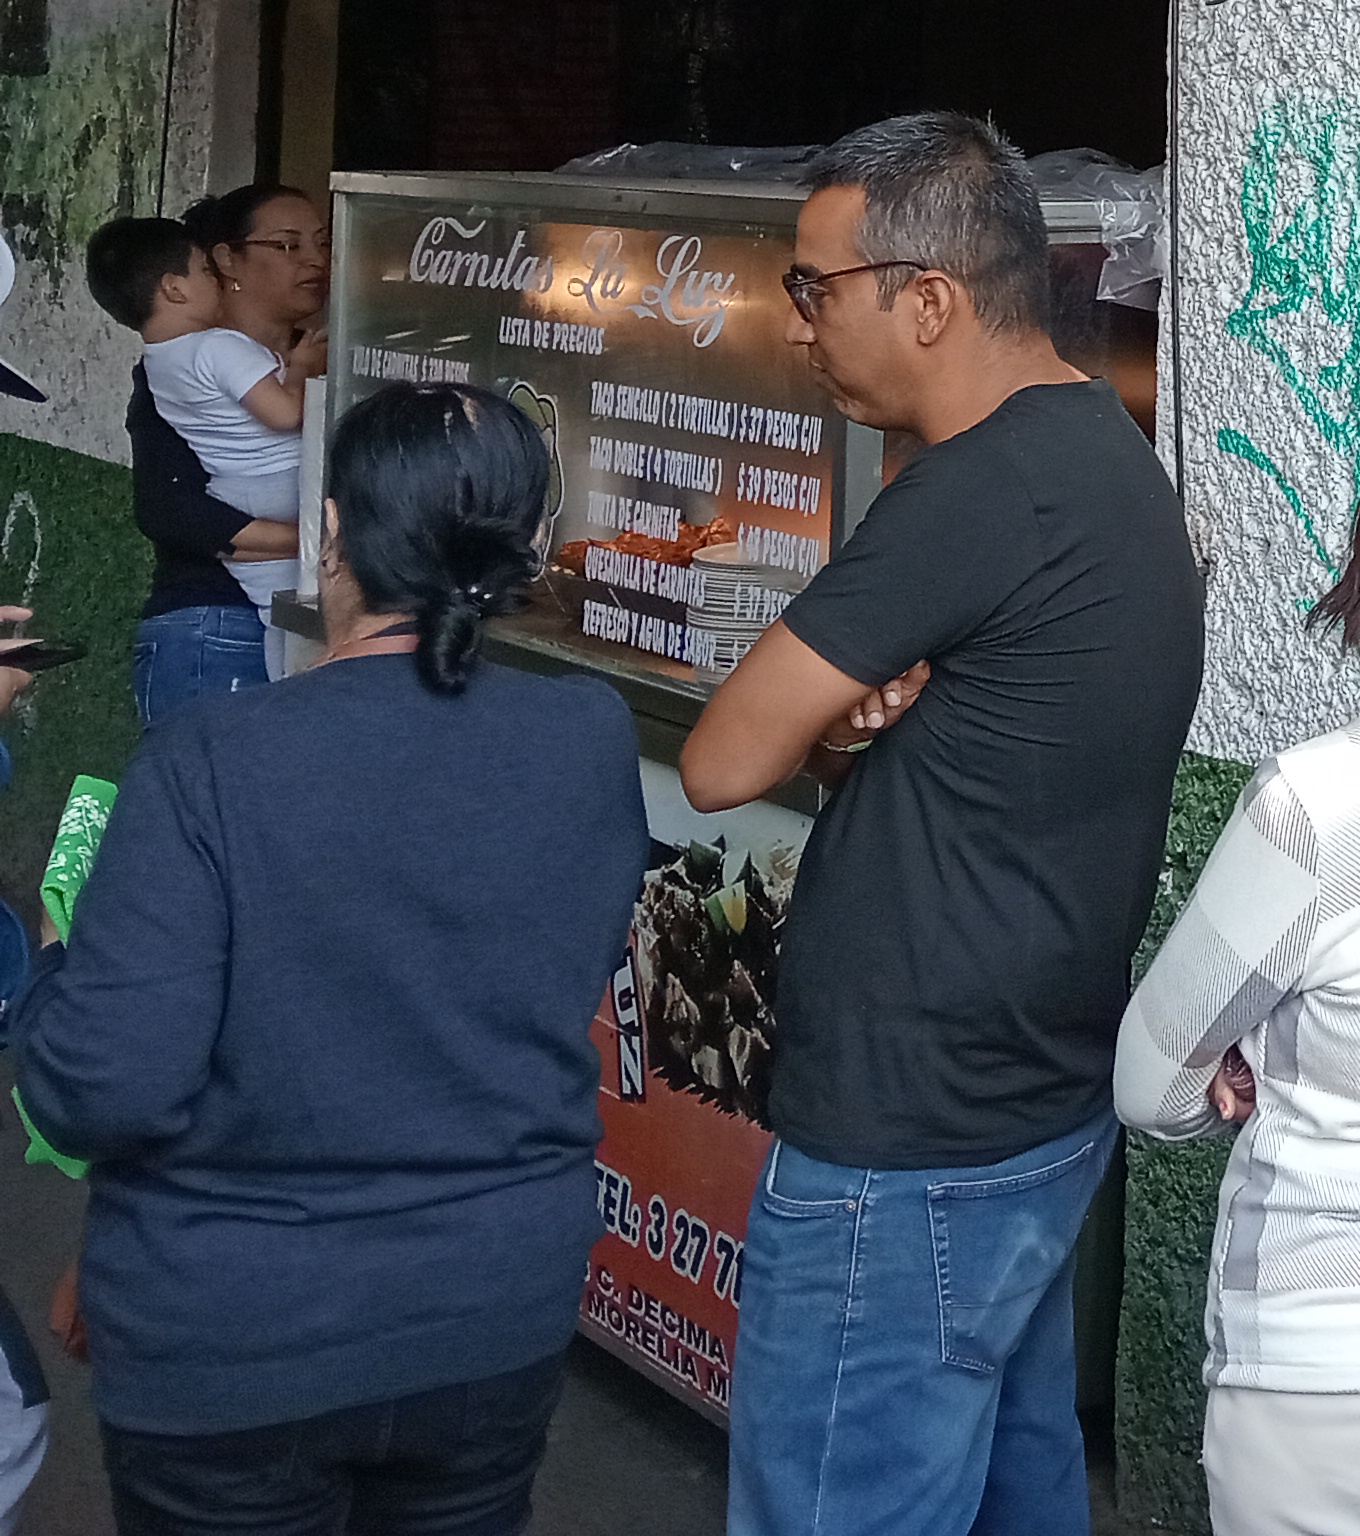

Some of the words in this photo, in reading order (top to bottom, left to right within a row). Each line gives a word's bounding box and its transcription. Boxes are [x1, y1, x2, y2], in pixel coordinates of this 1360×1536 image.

[410, 216, 554, 294] Carnitas
[567, 229, 629, 314] La
[499, 316, 531, 346] LISTA
[534, 320, 549, 349] DE
[553, 323, 606, 355] PRECIOS
[591, 381, 615, 416] TACO
[615, 384, 660, 425] SENCILLO
[677, 394, 731, 438] TORTILLAS
[764, 409, 800, 451] PESOS
[800, 415, 823, 457] C/U
[589, 436, 613, 471] TACO
[614, 439, 645, 478] DOBLE
[663, 449, 715, 494] TORTILLAS
[763, 468, 799, 510] PESOS
[799, 475, 821, 517] C/U
[617, 496, 634, 533] DE
[633, 500, 682, 543] CARNITAS
[762, 526, 797, 571] PESOS
[798, 534, 820, 578] C/U
[585, 545, 641, 592] QUESADILLA
[642, 558, 658, 594] DE
[658, 562, 707, 608] CARNITAS
[762, 588, 791, 624] PES
[583, 599, 630, 643] REFRESCO
[630, 611, 639, 647] Y
[638, 615, 666, 656] AGUA
[667, 622, 683, 659] DE
[682, 626, 717, 672] SABOR
[593, 1159, 642, 1248] TEL:
[646, 1194, 668, 1261] 3
[671, 1208, 711, 1284] 27
[588, 1290, 702, 1390] MORELIA
[597, 1267, 622, 1304] C.
[627, 1284, 730, 1373] DECIMA
